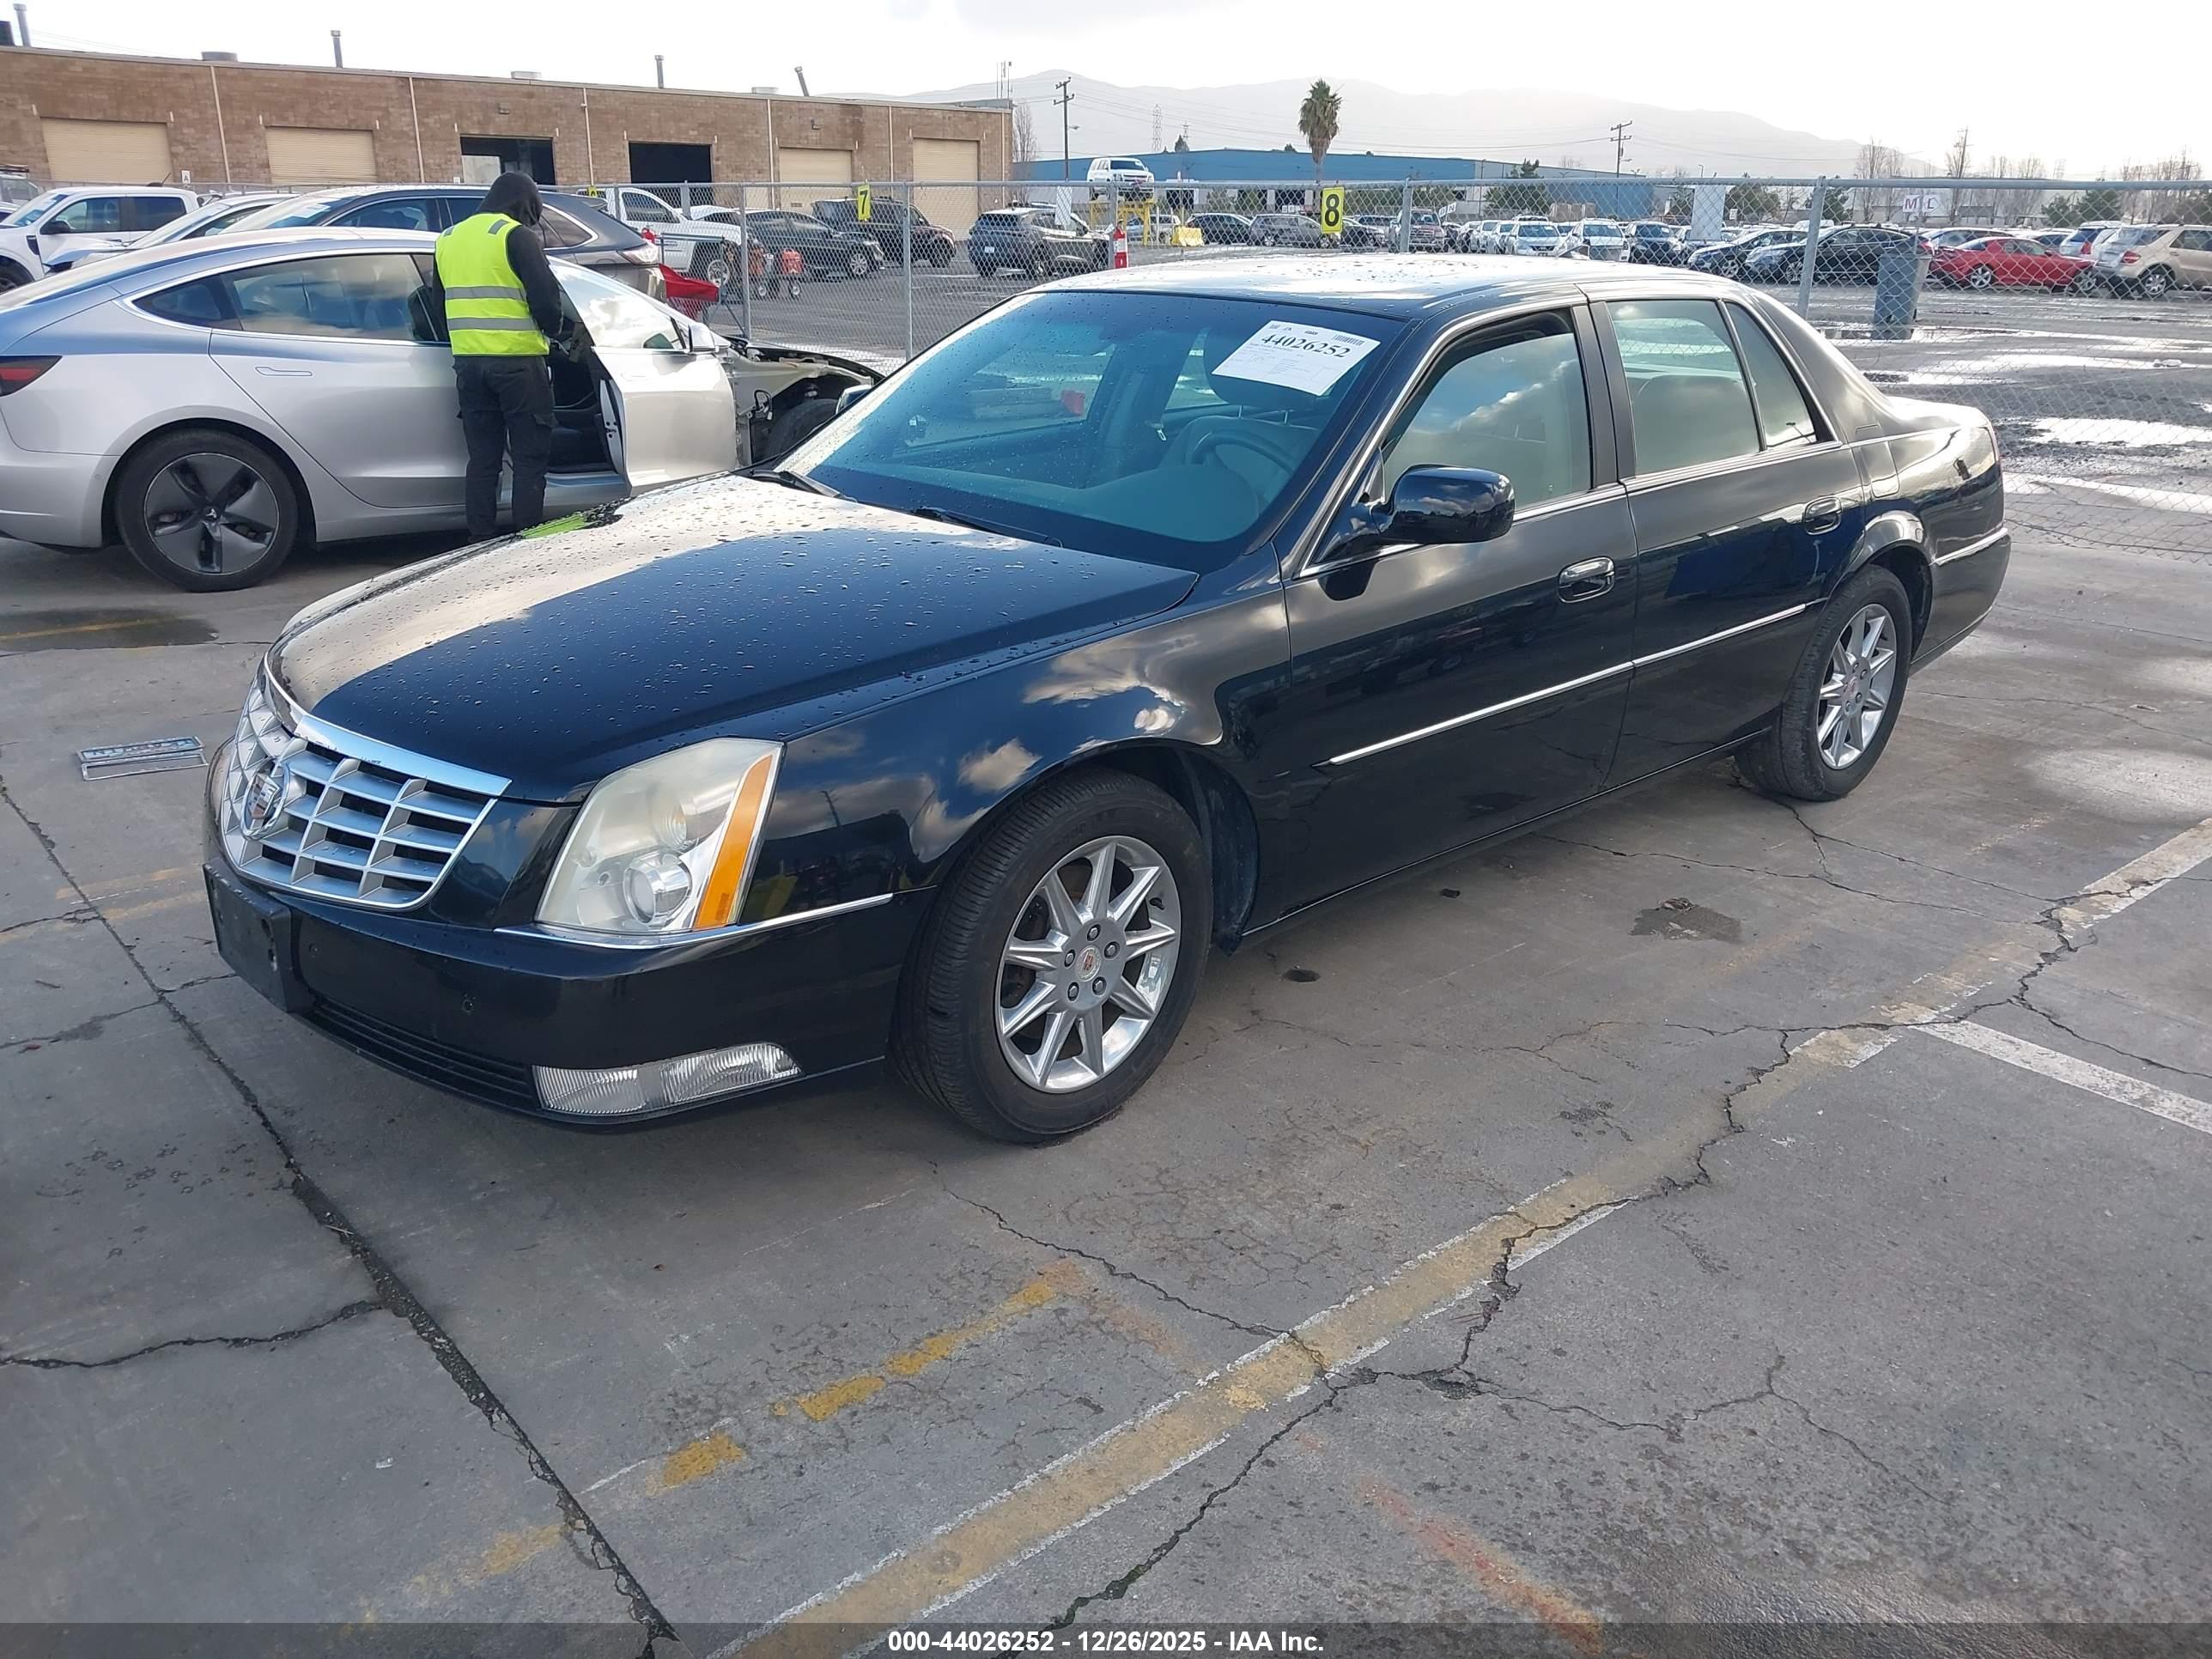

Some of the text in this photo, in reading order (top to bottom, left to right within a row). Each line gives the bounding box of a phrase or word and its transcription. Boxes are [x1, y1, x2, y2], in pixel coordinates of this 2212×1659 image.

[860, 190, 868, 215] 7
[1325, 194, 1340, 227] 8
[1905, 198, 1917, 210] M
[1261, 333, 1352, 359] 44026252
